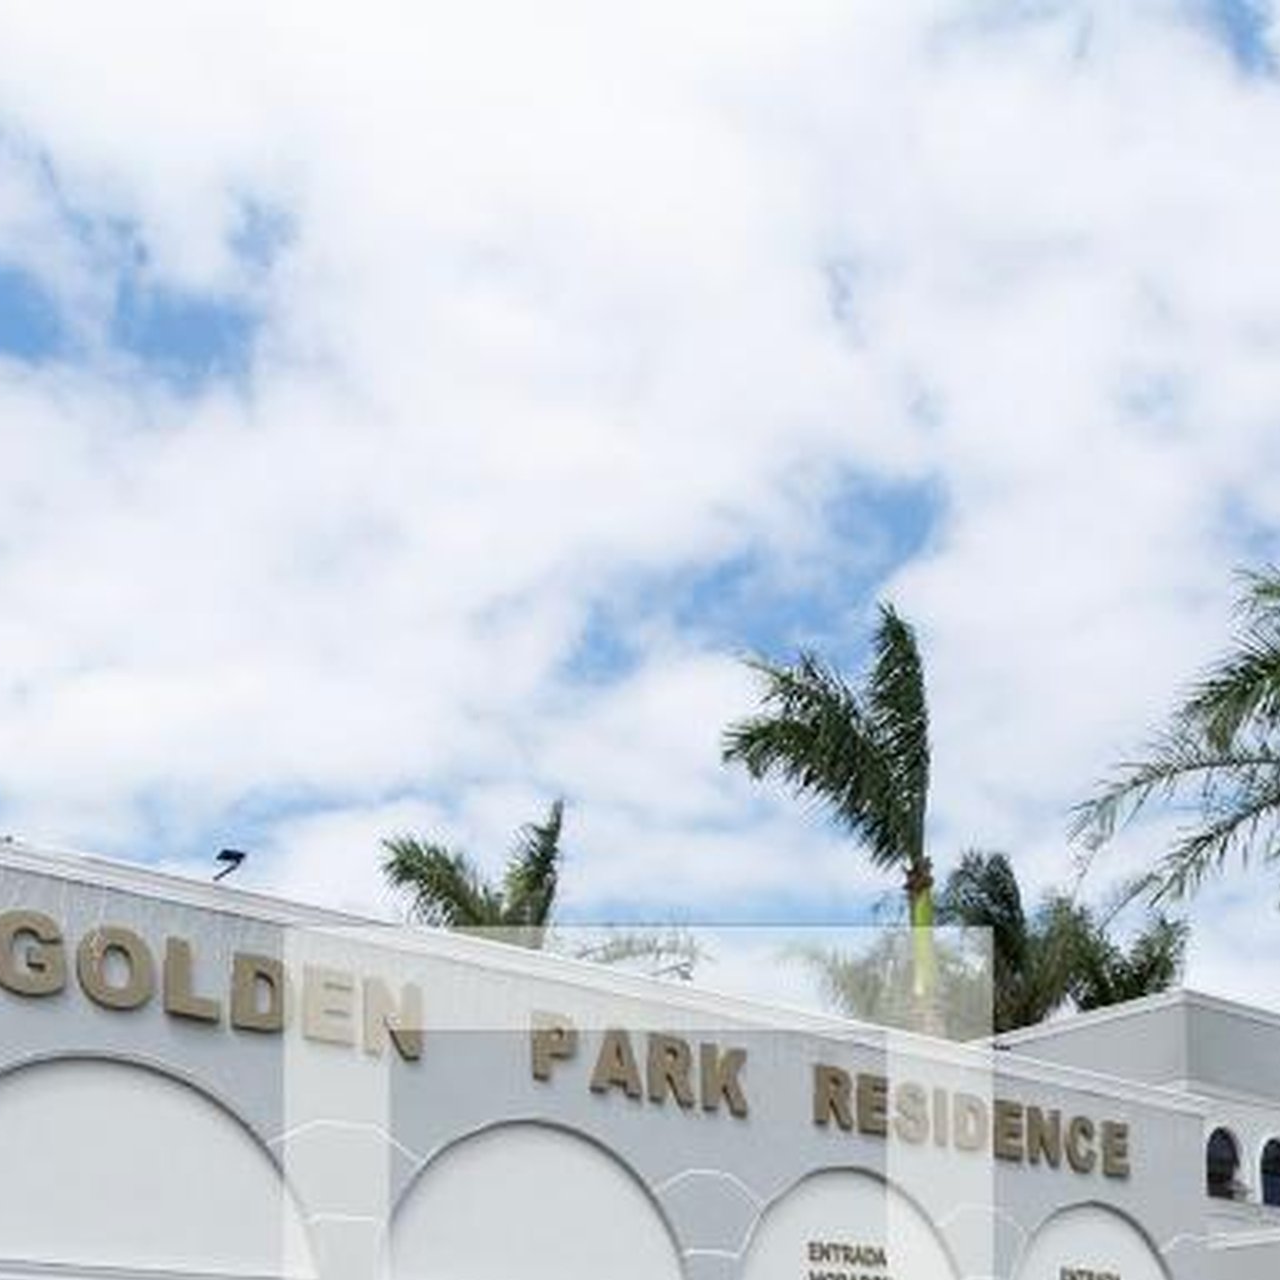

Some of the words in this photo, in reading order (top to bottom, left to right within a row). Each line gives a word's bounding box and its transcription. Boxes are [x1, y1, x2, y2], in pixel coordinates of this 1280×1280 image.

[529, 1010, 749, 1119] PARK
[812, 1063, 1131, 1180] RESIDENCE
[807, 1241, 888, 1268] ENTRADA
